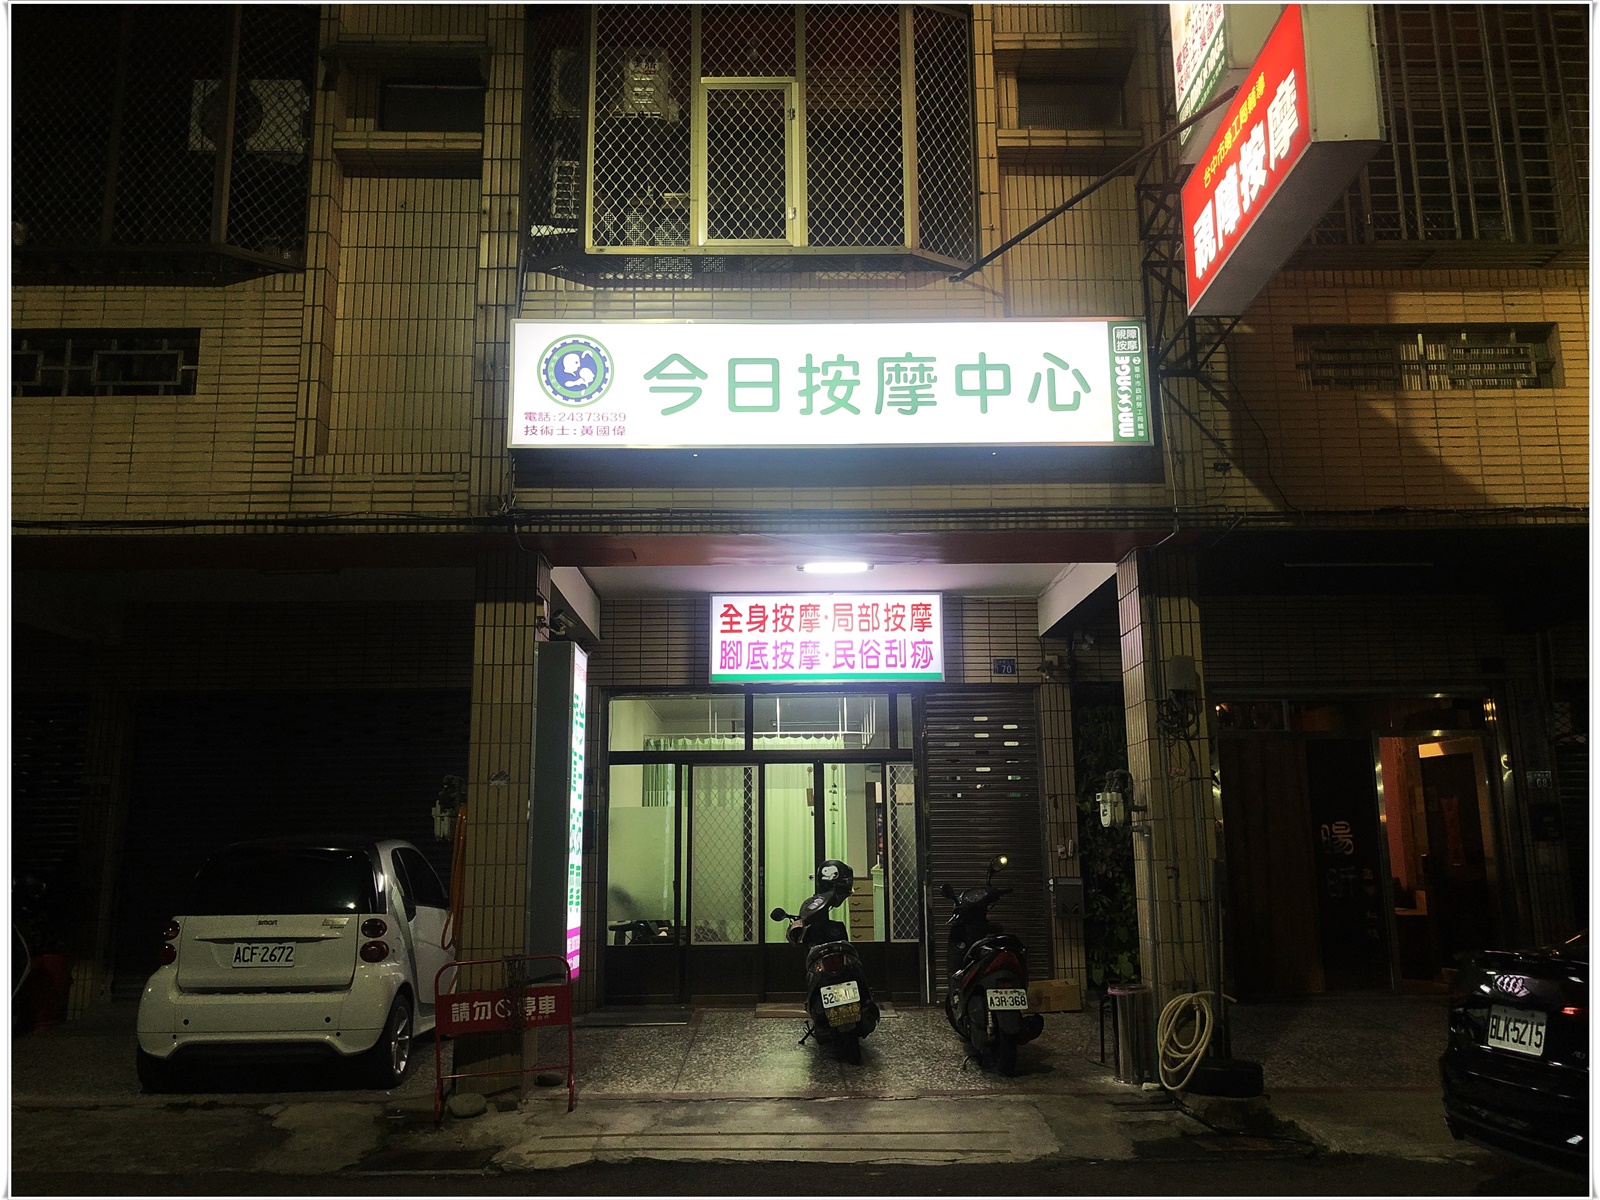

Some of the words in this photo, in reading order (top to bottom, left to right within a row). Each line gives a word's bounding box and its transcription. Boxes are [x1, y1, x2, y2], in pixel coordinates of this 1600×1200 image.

[1203, 71, 1266, 188] 台中市勞工局輔導
[1193, 68, 1299, 280] 視障按摩
[643, 351, 1091, 416] 今日按摩中心
[1002, 665, 1012, 673] 70
[234, 946, 293, 963] ACF-2672
[990, 996, 1026, 1007] A3R-368
[1490, 1015, 1545, 1048] BLK-5215
